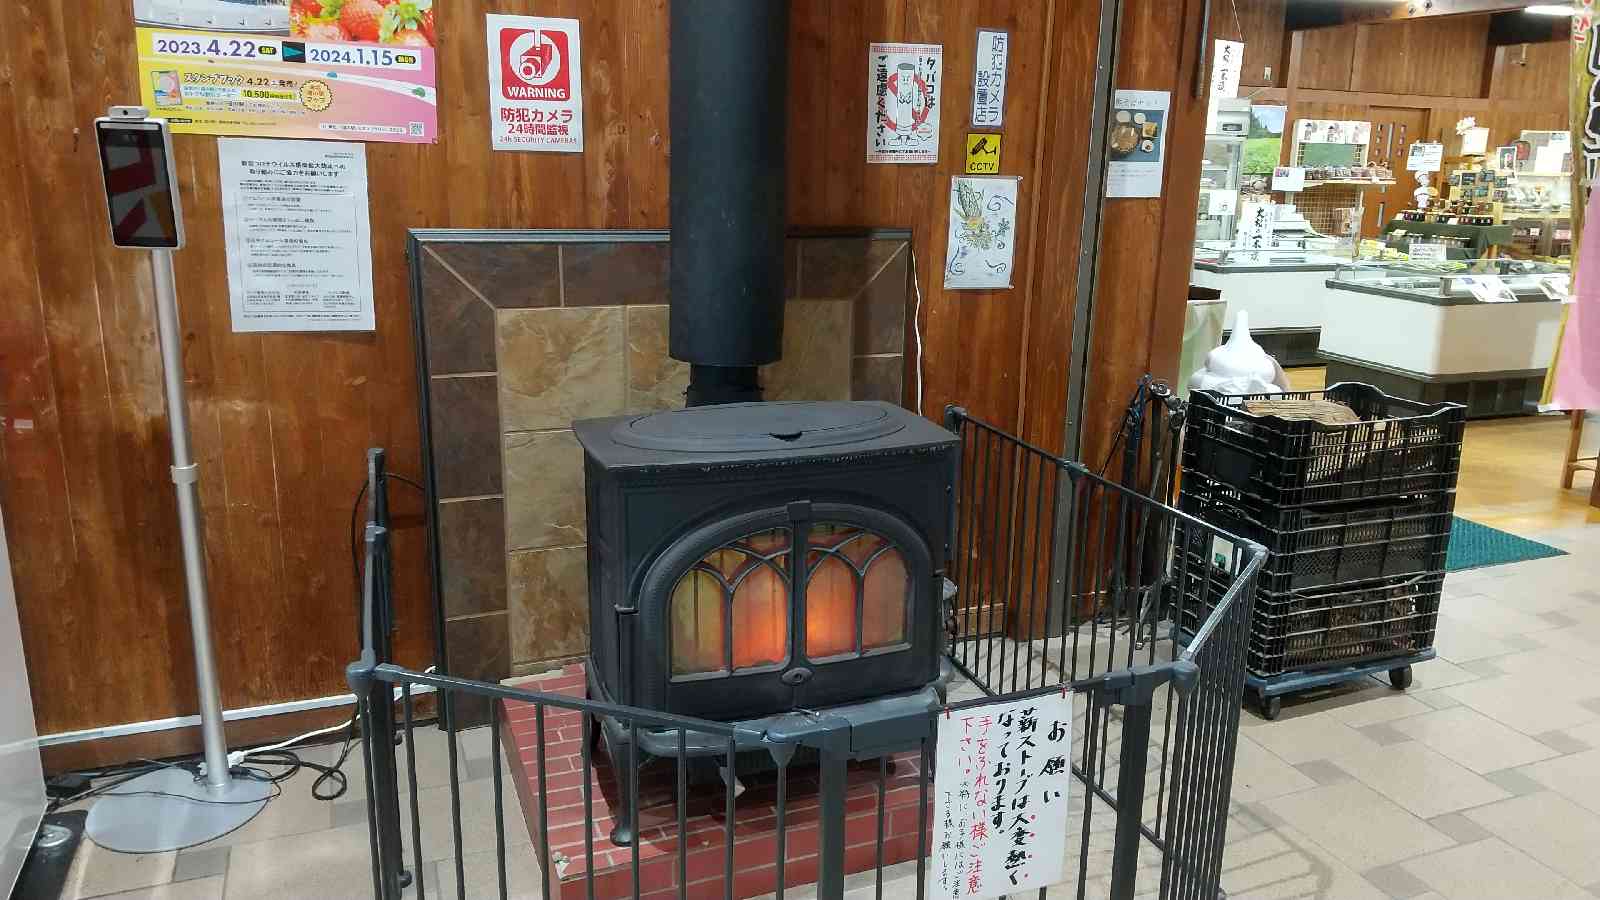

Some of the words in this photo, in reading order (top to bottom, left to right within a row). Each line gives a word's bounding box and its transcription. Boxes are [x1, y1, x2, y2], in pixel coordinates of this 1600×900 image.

[157, 39, 257, 58] 2023.4.22
[310, 48, 393, 66] 2024.1.15
[924, 57, 936, 109] タバコは
[989, 35, 1005, 122] 防犯カメラ
[507, 86, 566, 98] WARNING
[500, 107, 573, 123] 防犯カメラ
[507, 123, 569, 135] 24時間監視
[970, 162, 994, 171] CCTV
[1039, 720, 1068, 804] お願い
[967, 715, 993, 896] 手をふれない様ご注意
[1005, 706, 1039, 886] 薪ストーブは大変熱く
